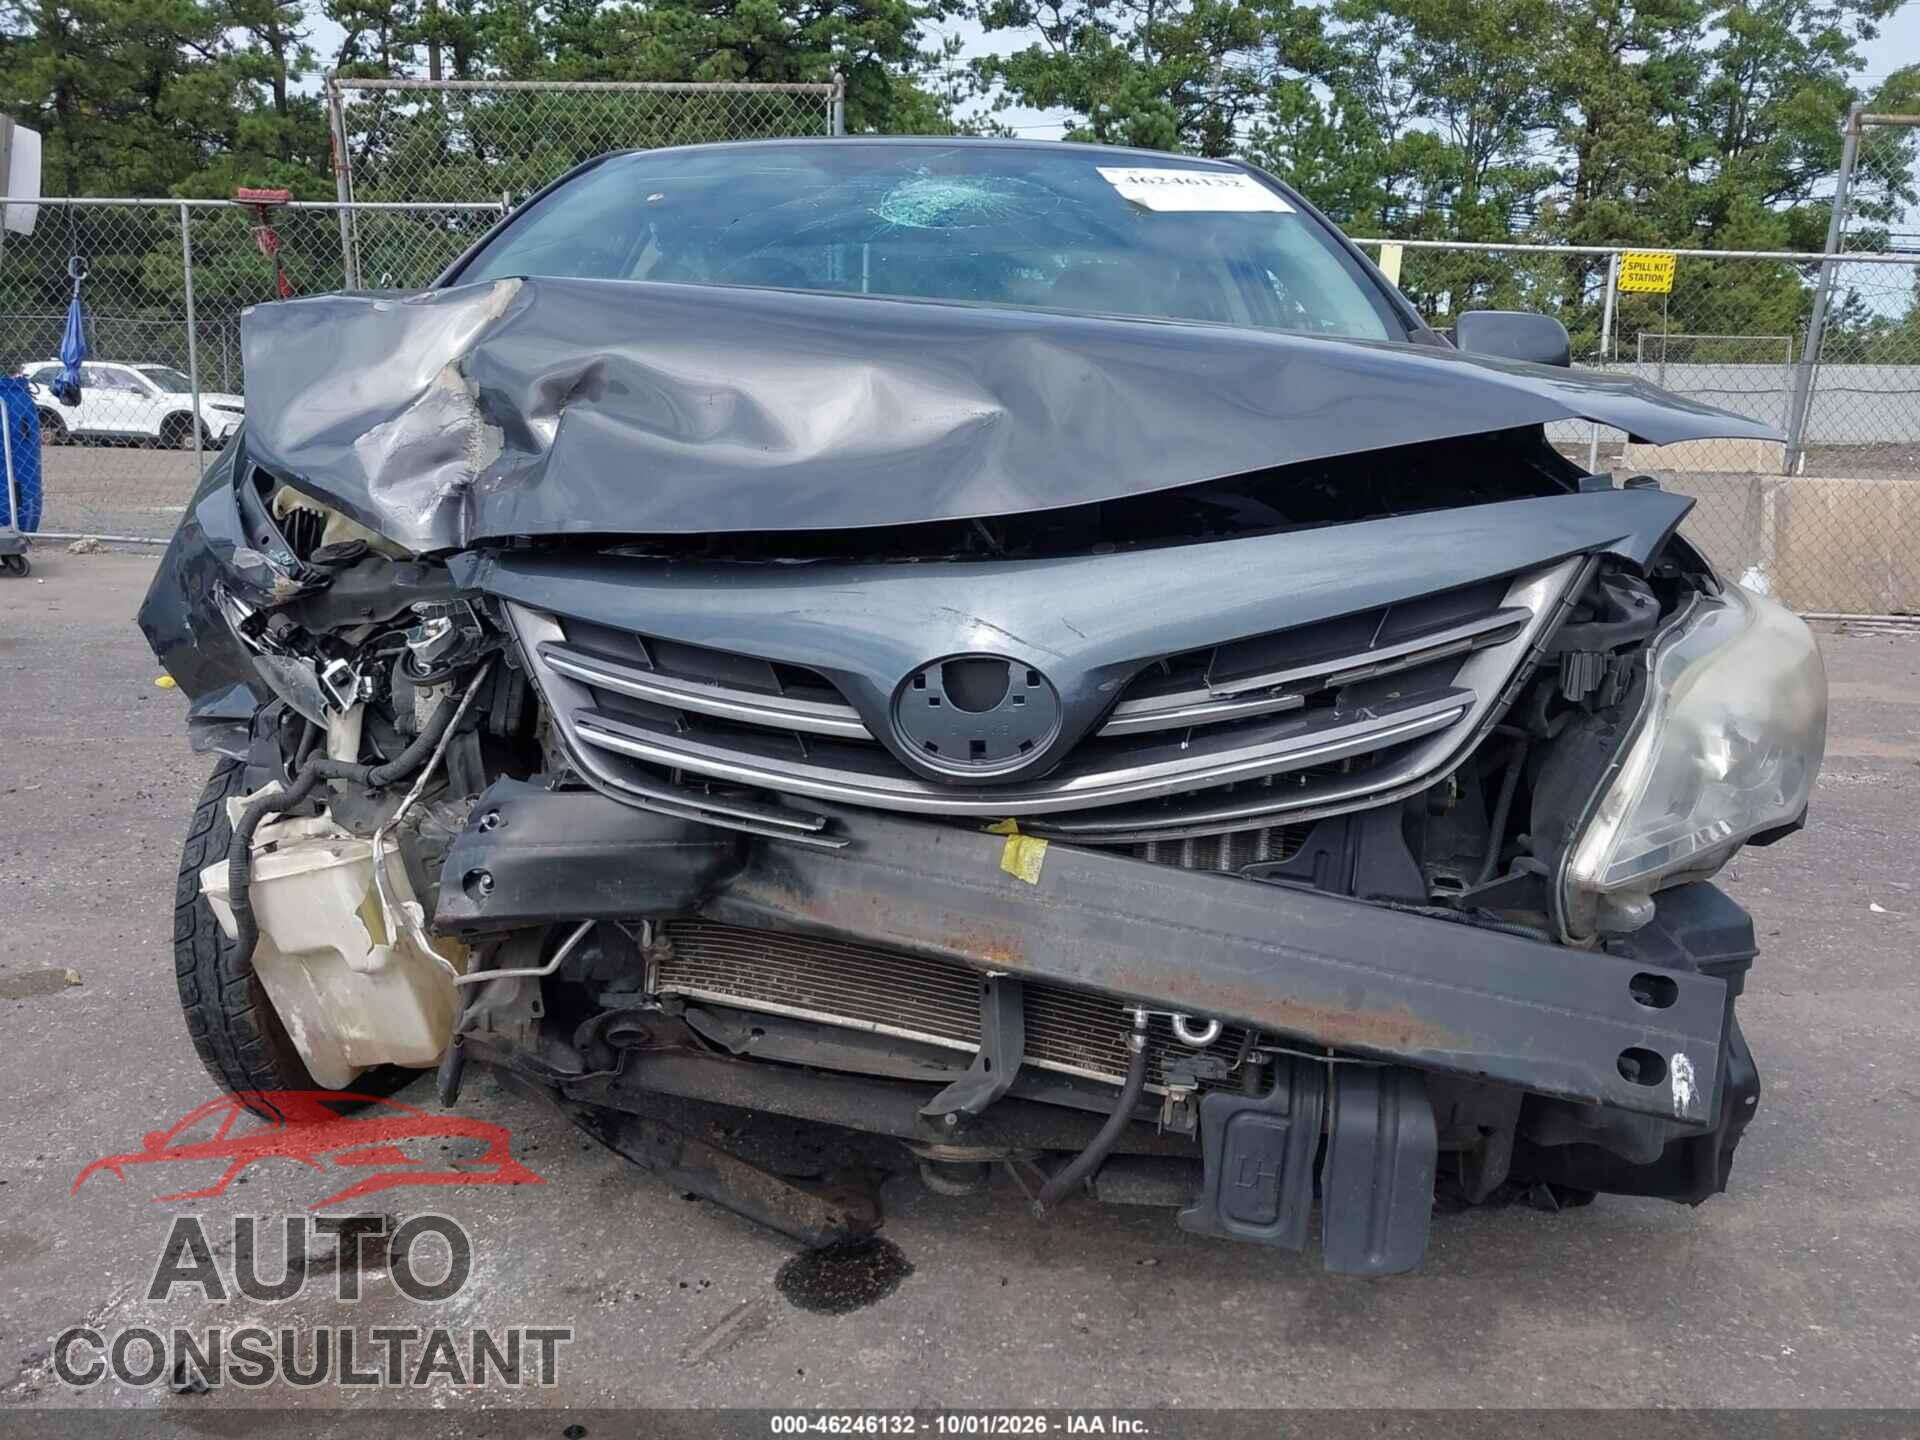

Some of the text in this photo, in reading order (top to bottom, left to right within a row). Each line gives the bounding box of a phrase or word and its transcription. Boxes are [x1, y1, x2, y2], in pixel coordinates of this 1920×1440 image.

[1126, 176, 1245, 187] 46246132
[1628, 262, 1668, 272] SPILL KIT
[1628, 273, 1664, 282] STATION
